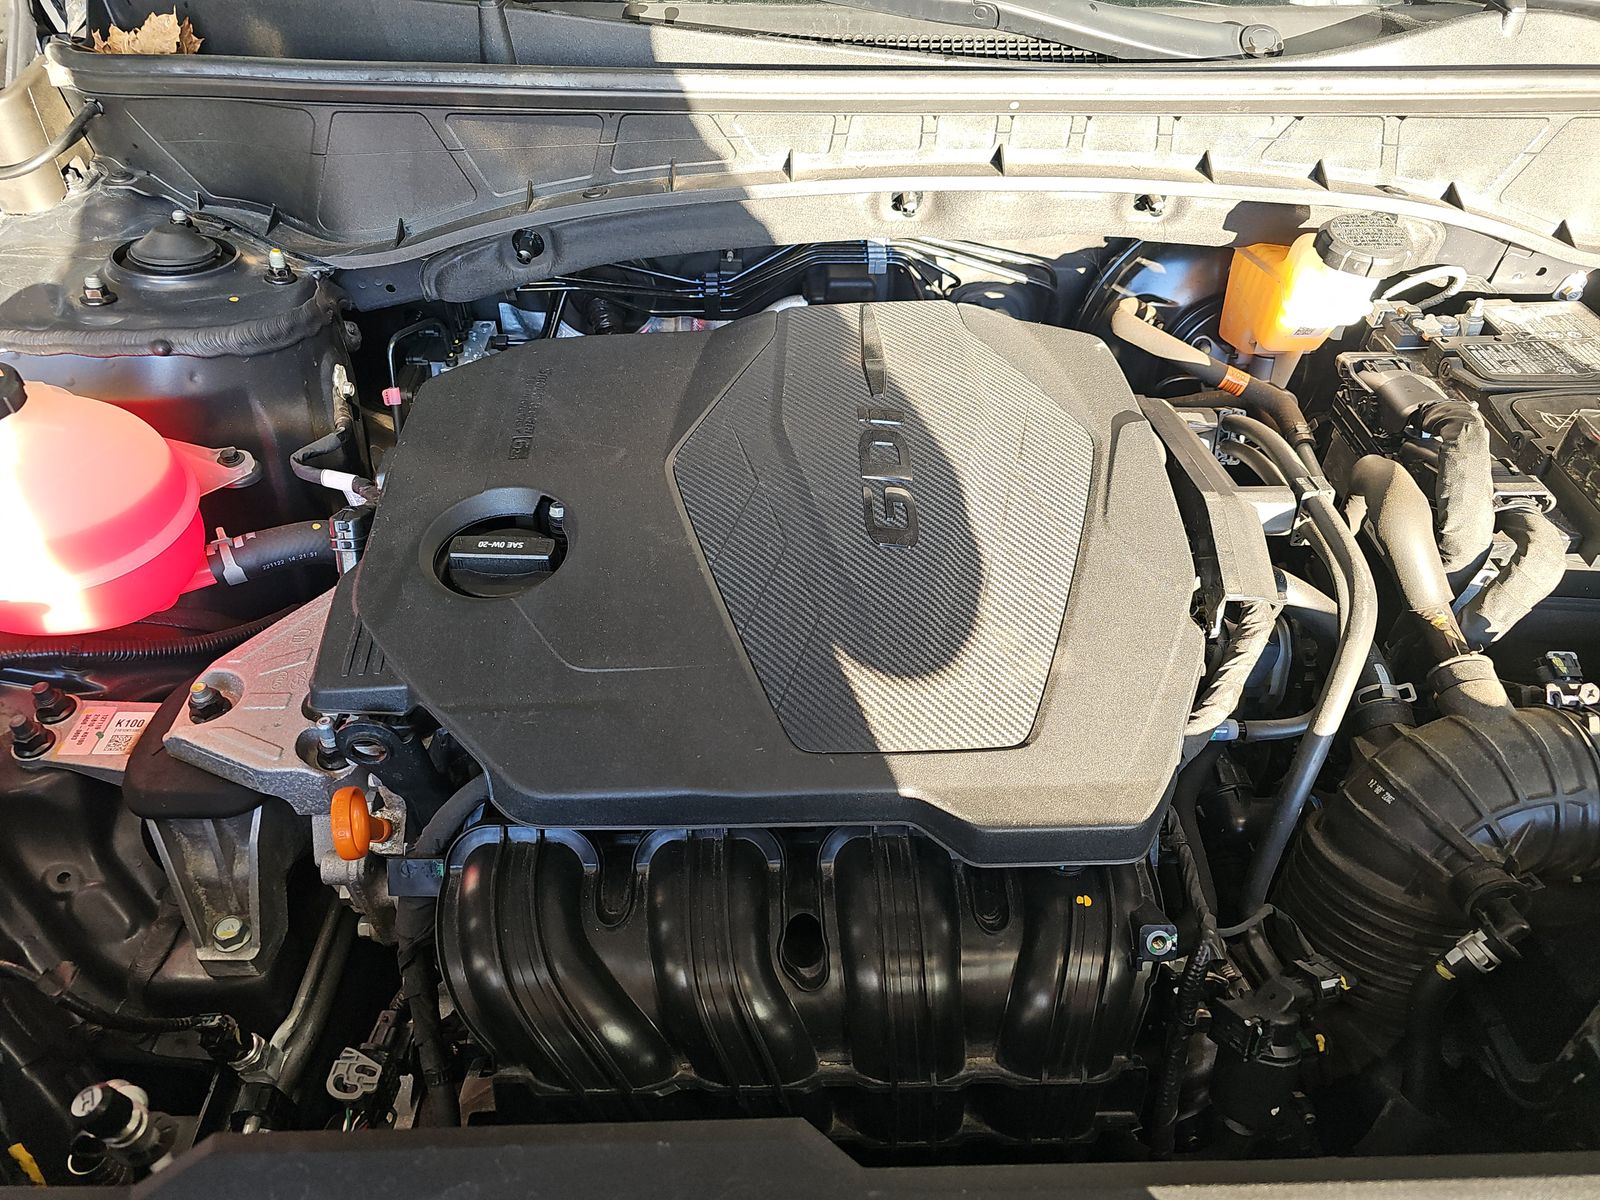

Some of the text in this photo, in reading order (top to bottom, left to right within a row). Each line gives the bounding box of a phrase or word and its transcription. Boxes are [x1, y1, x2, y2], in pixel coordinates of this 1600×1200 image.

[477, 540, 525, 549] SAE 0W-20
[262, 559, 286, 571] 221122
[115, 718, 146, 728] K100
